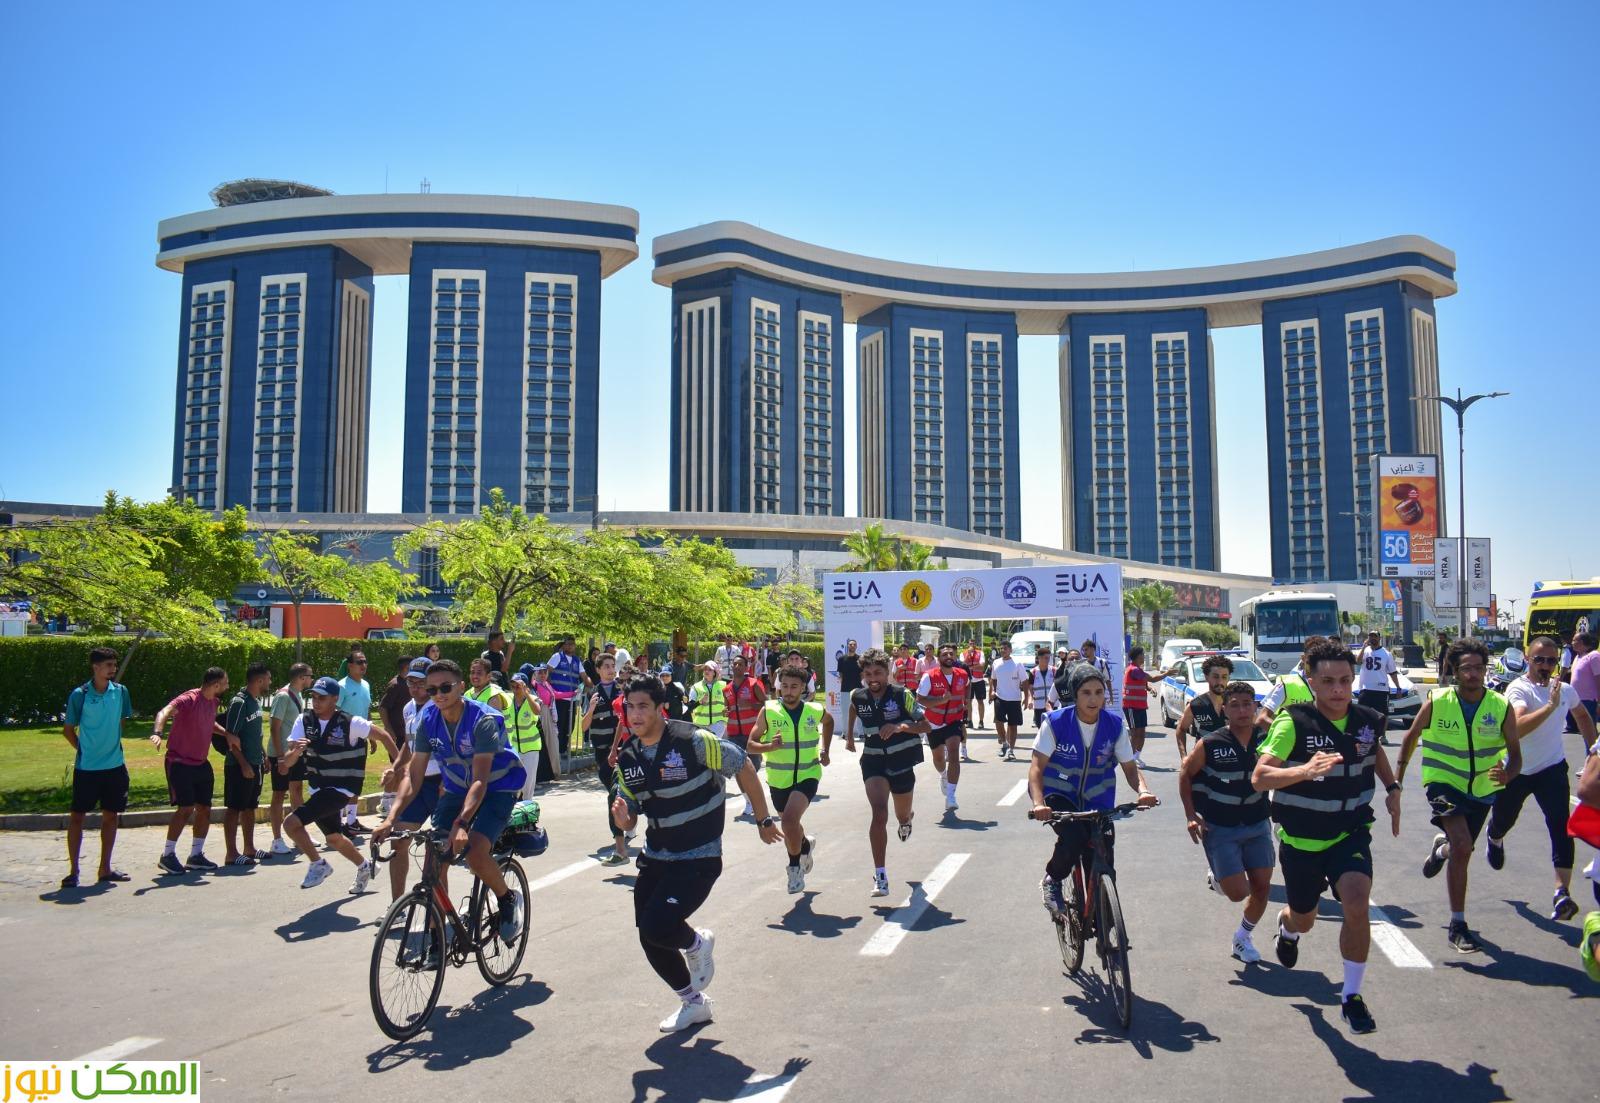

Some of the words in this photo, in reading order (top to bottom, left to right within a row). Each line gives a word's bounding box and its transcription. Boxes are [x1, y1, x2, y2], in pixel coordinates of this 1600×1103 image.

[1385, 536, 1408, 557] 50
[833, 580, 881, 600] EUA
[1056, 573, 1108, 594] EUA
[1366, 657, 1381, 670] 85
[772, 719, 789, 728] EUA
[1438, 719, 1459, 729] EUA
[1306, 735, 1334, 748] EUA
[1056, 744, 1077, 753] EUA
[1213, 748, 1237, 759] EUA
[624, 765, 644, 780] EUA
